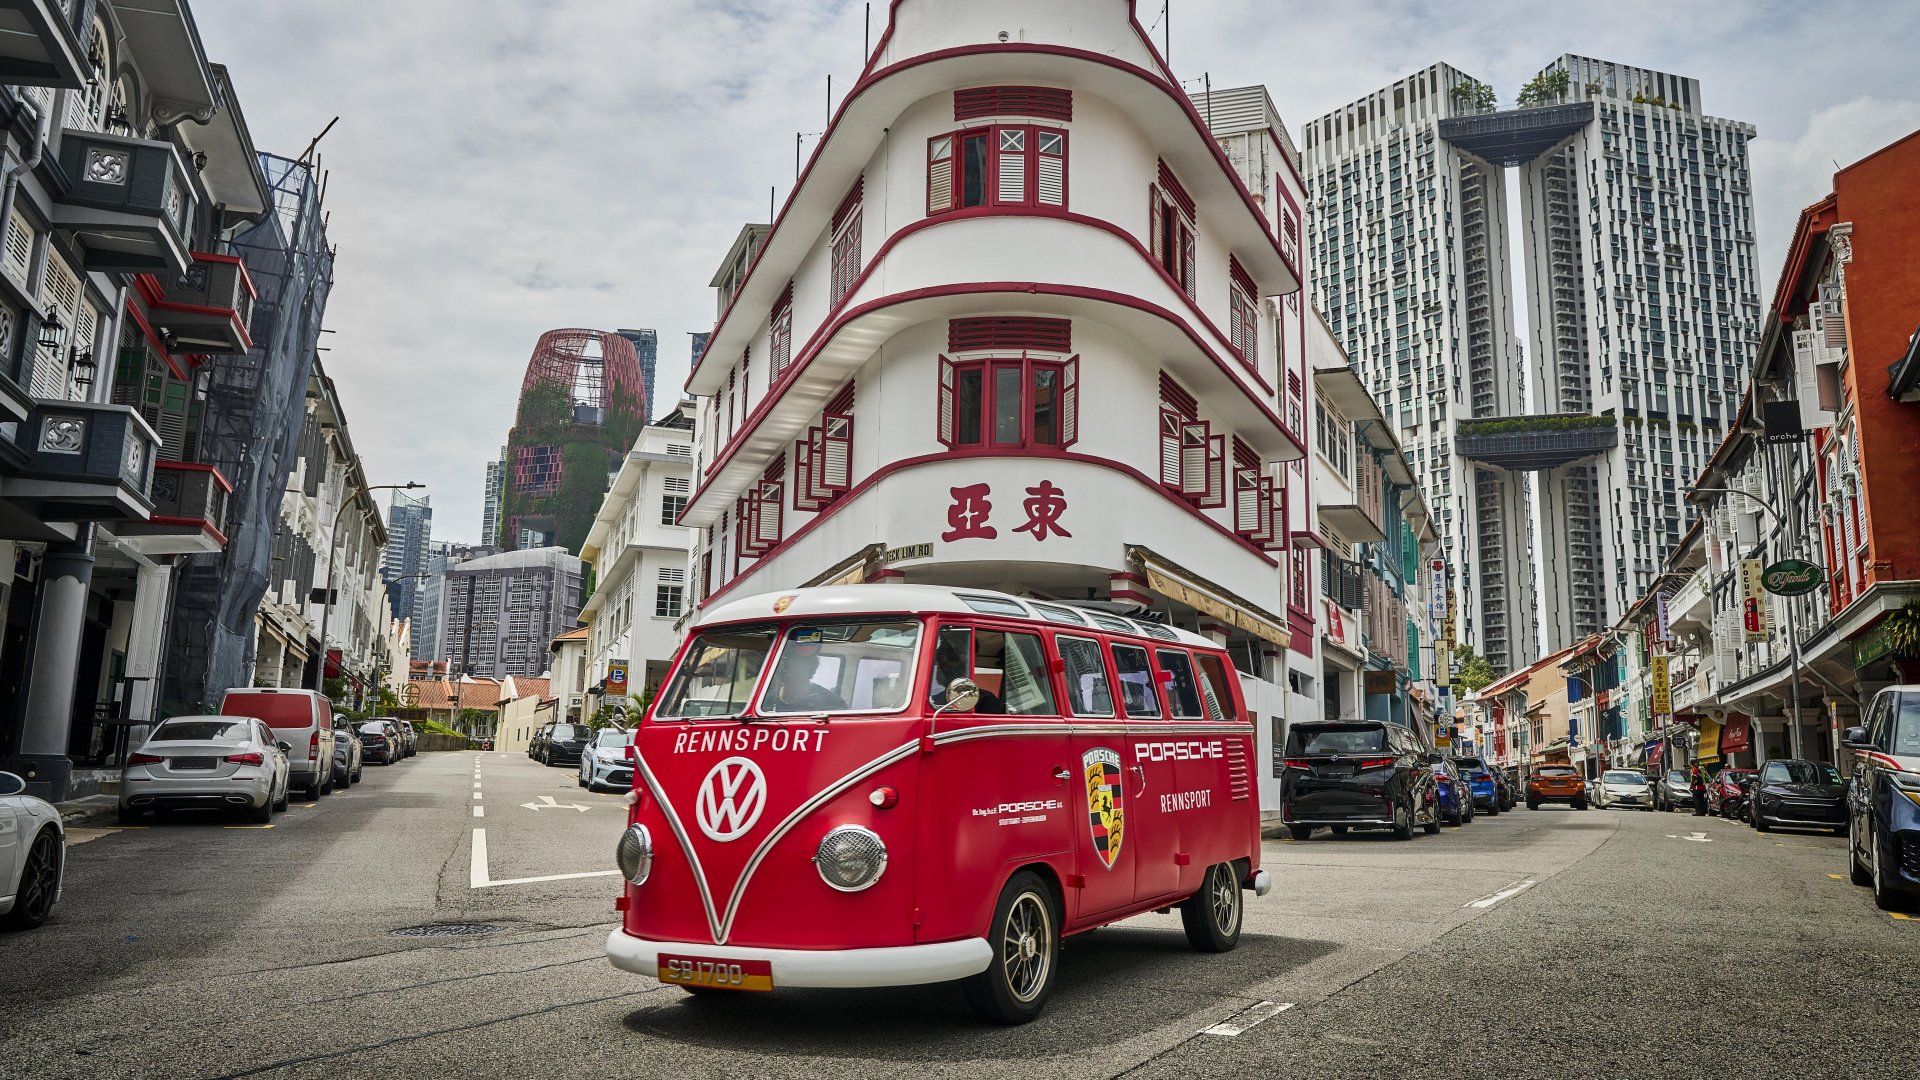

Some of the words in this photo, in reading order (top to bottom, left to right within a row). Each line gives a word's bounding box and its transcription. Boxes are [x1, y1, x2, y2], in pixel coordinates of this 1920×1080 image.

[885, 549, 900, 563] TECK
[902, 545, 916, 559] LIM
[918, 544, 930, 556] RD
[1742, 563, 1751, 597] FOCUS
[674, 728, 829, 753] RENNSPORT
[1083, 748, 1120, 768] PORSCHE
[1135, 741, 1223, 762] PORSCHE
[999, 800, 1056, 813] PORSCHE
[1161, 790, 1211, 813] RENNSPORT
